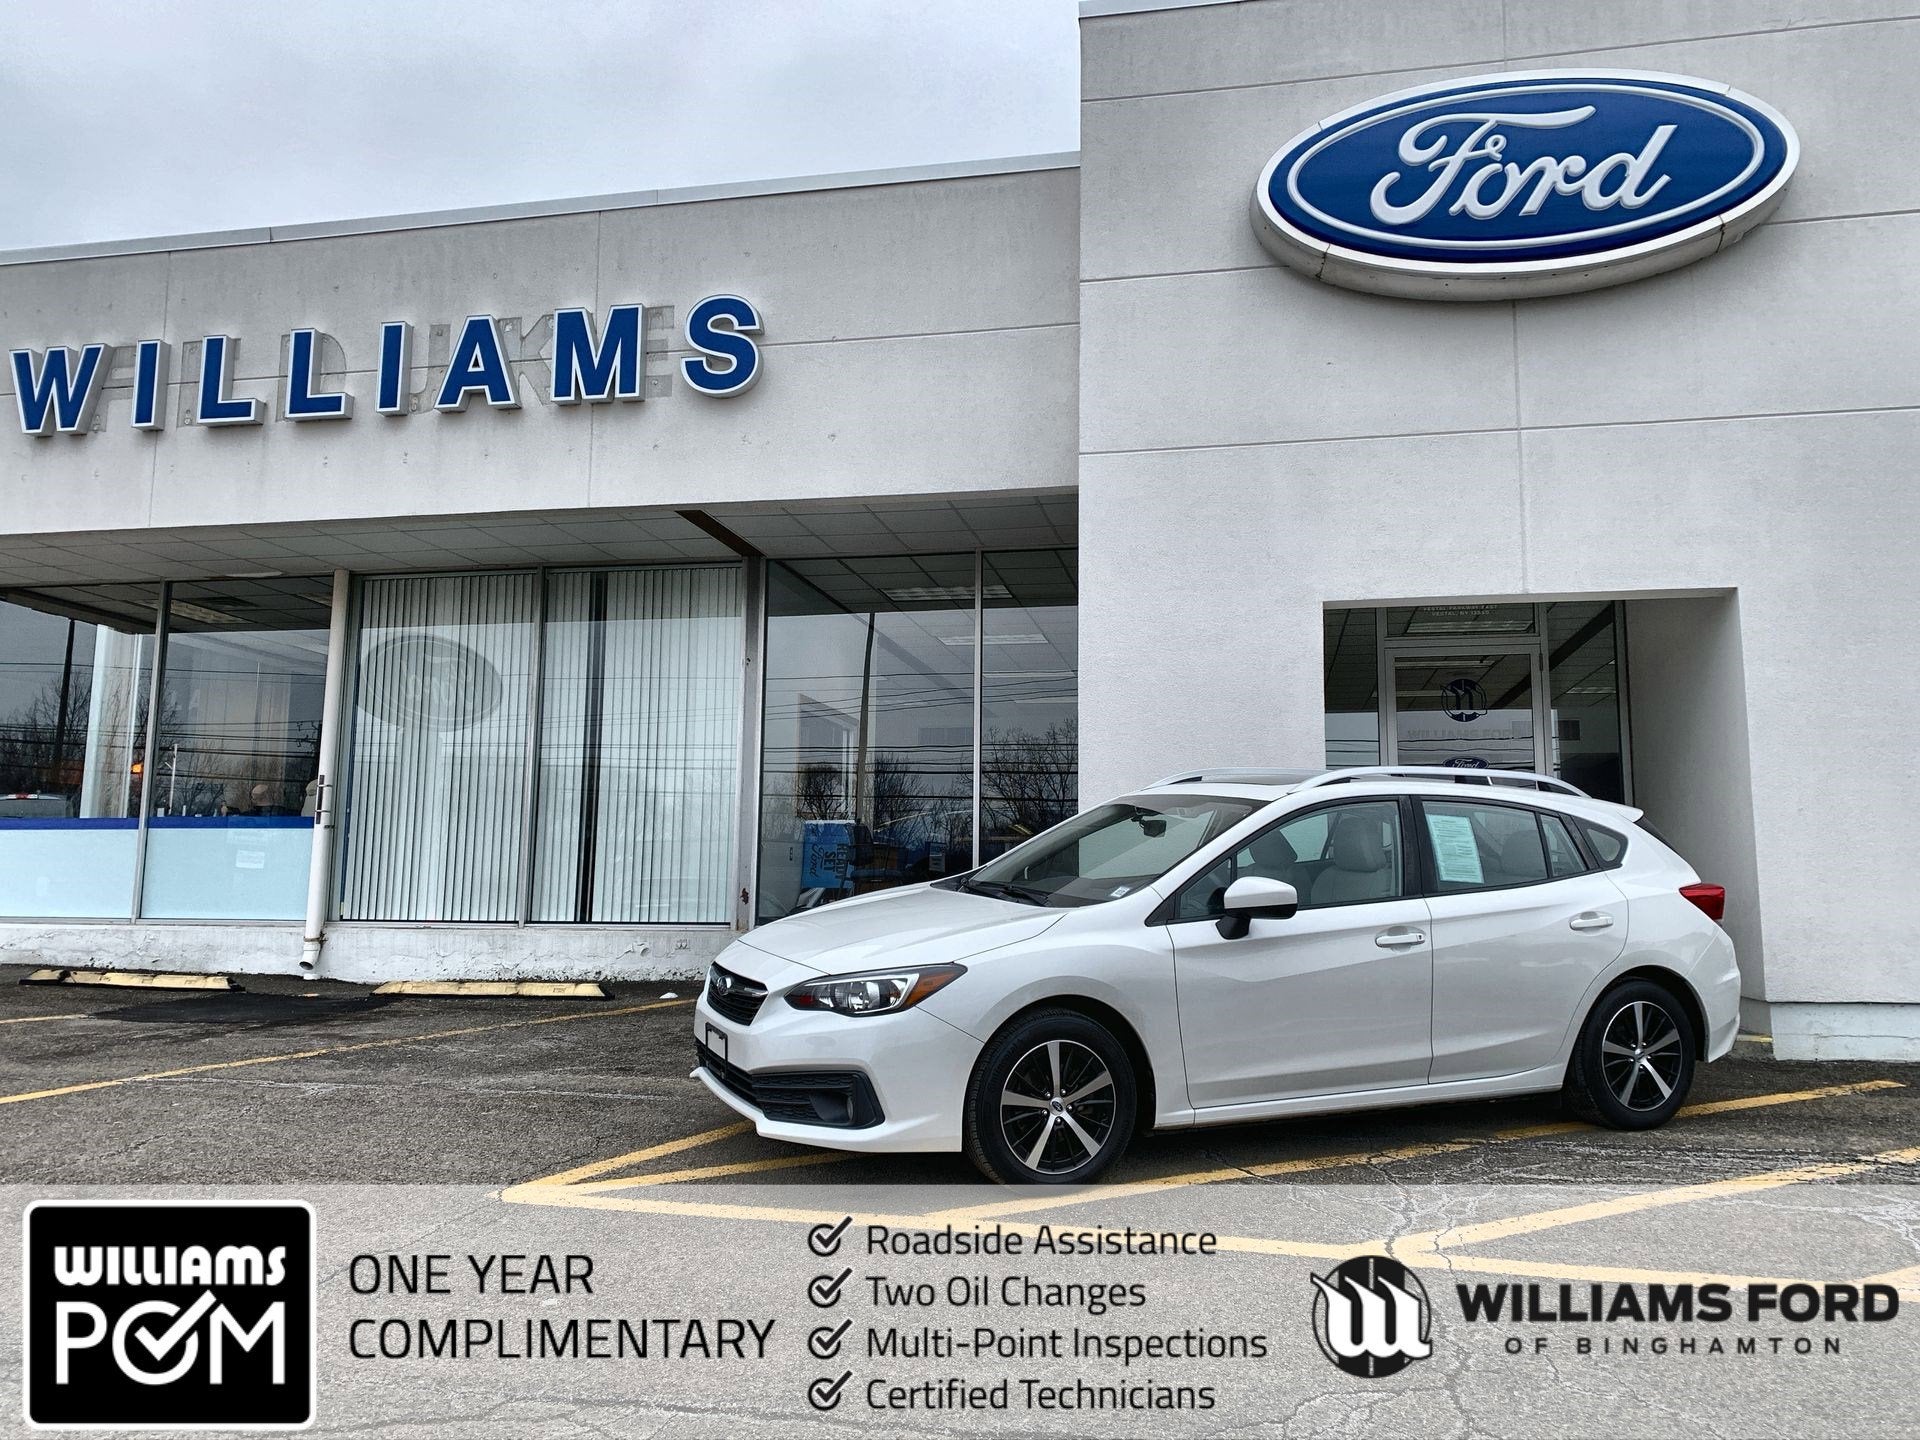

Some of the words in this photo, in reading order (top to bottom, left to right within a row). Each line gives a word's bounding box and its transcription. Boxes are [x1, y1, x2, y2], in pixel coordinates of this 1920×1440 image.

[1370, 104, 1678, 226] Ford
[10, 293, 764, 438] WILLIAMS
[1452, 758, 1480, 769] Ford
[809, 843, 825, 878] Ford
[824, 851, 836, 873] SET
